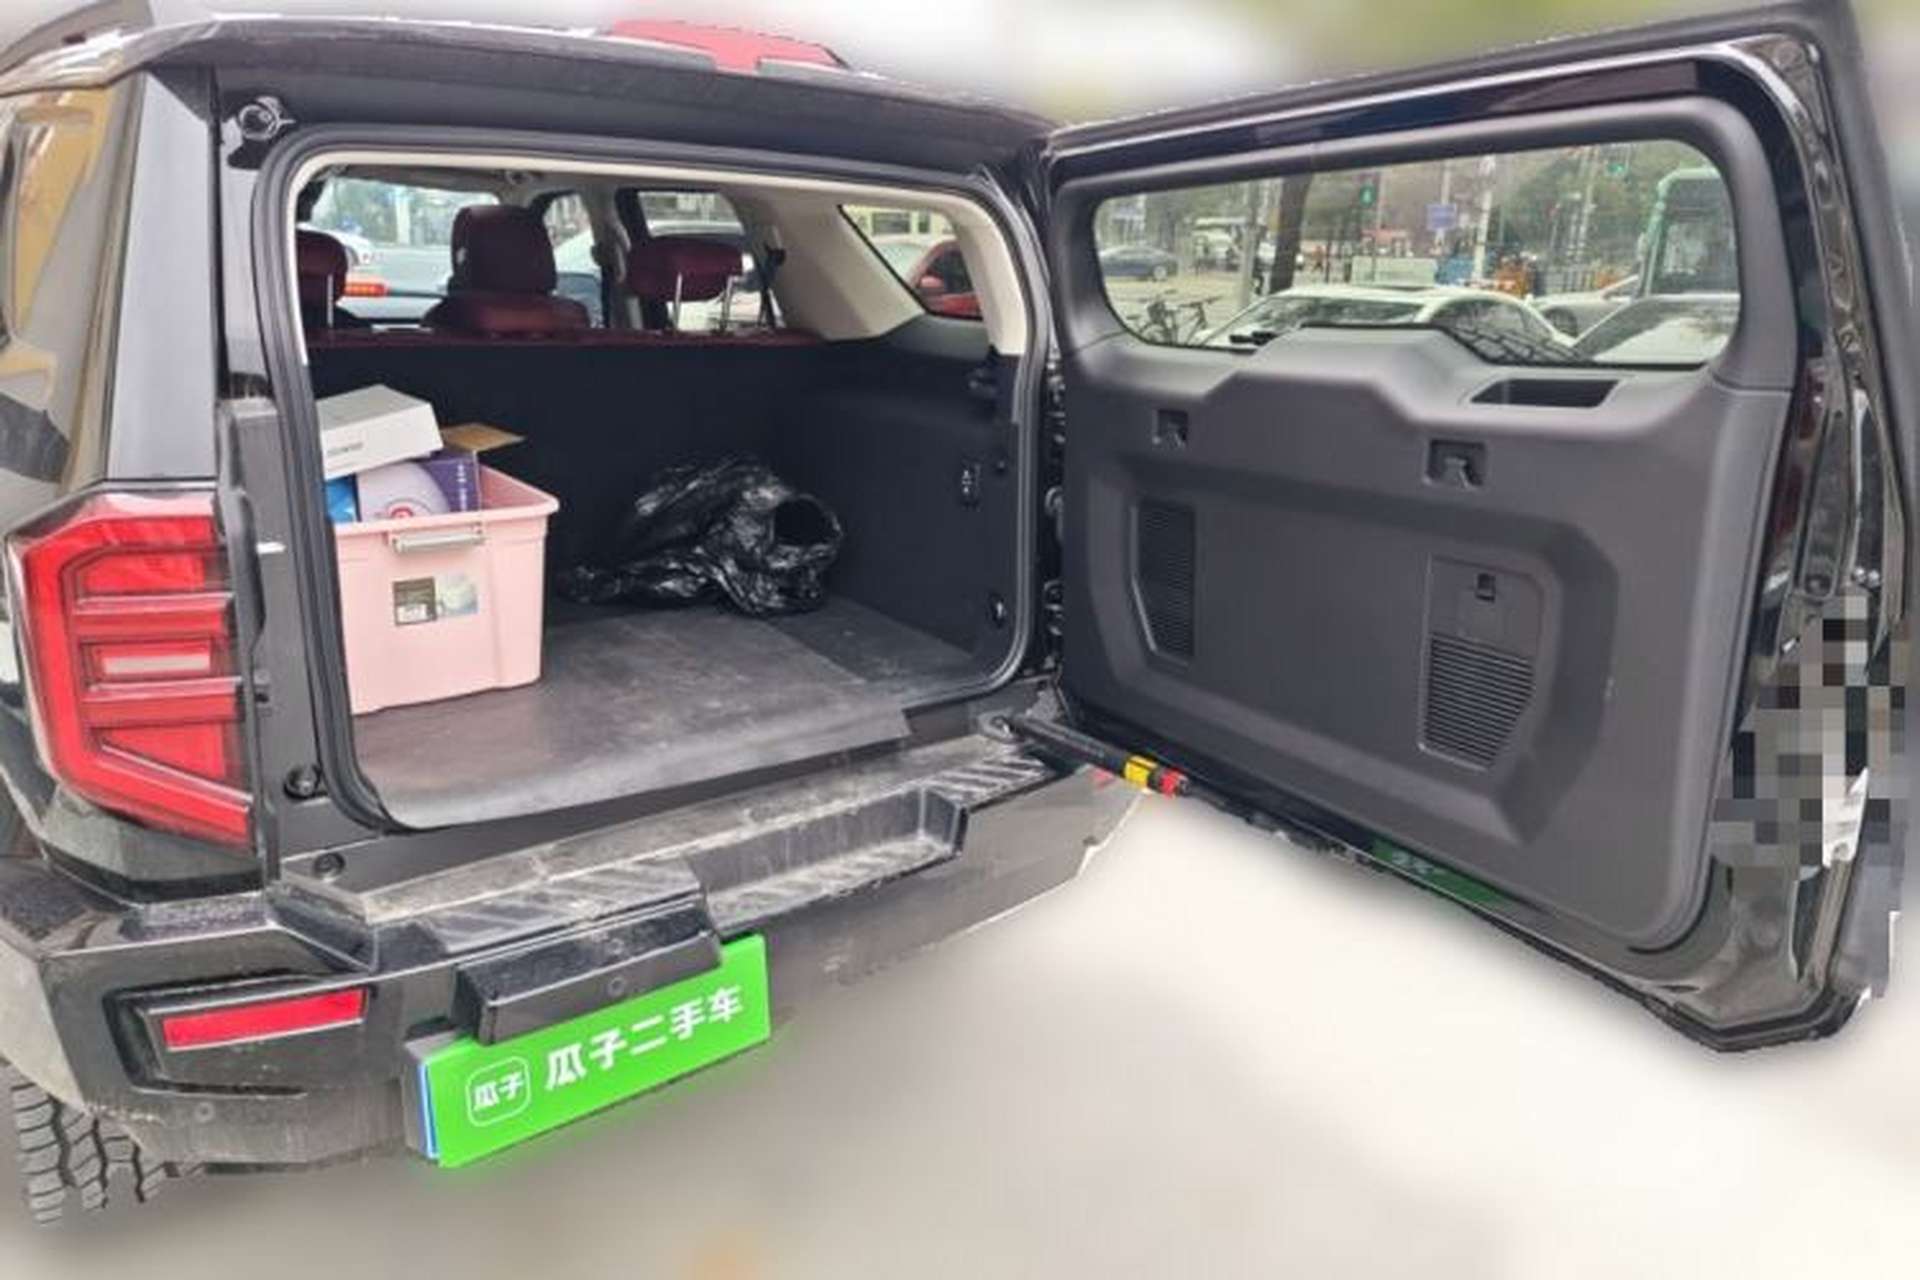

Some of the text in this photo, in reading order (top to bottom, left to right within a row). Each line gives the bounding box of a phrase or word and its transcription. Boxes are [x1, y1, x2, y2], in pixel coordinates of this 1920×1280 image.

[546, 985, 743, 1091] 瓜子二手车
[474, 1073, 523, 1111] 瓜子
